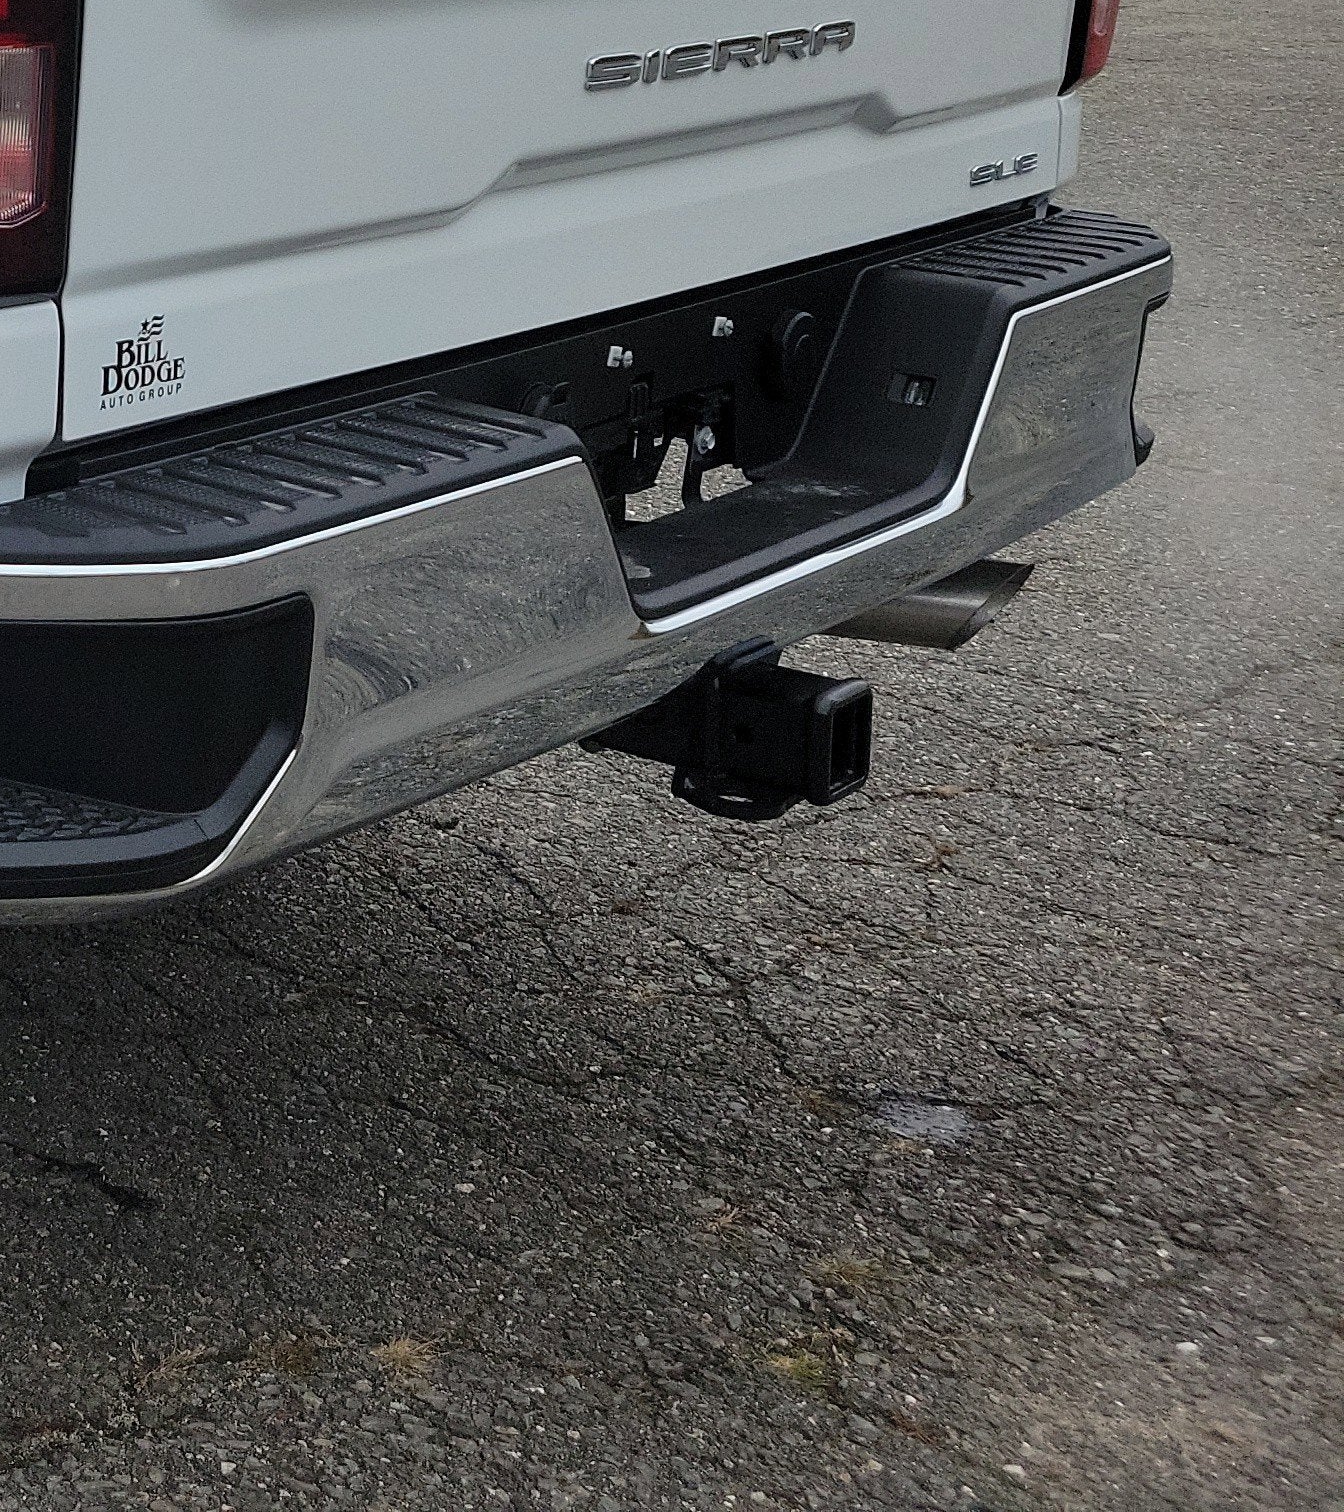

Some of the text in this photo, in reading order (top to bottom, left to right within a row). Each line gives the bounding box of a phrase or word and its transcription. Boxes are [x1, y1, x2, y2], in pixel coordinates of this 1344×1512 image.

[585, 19, 856, 93] SIERRA
[969, 151, 1038, 187] SLE
[101, 357, 186, 397] DODGE
[99, 382, 183, 411] AUTO GROUP
